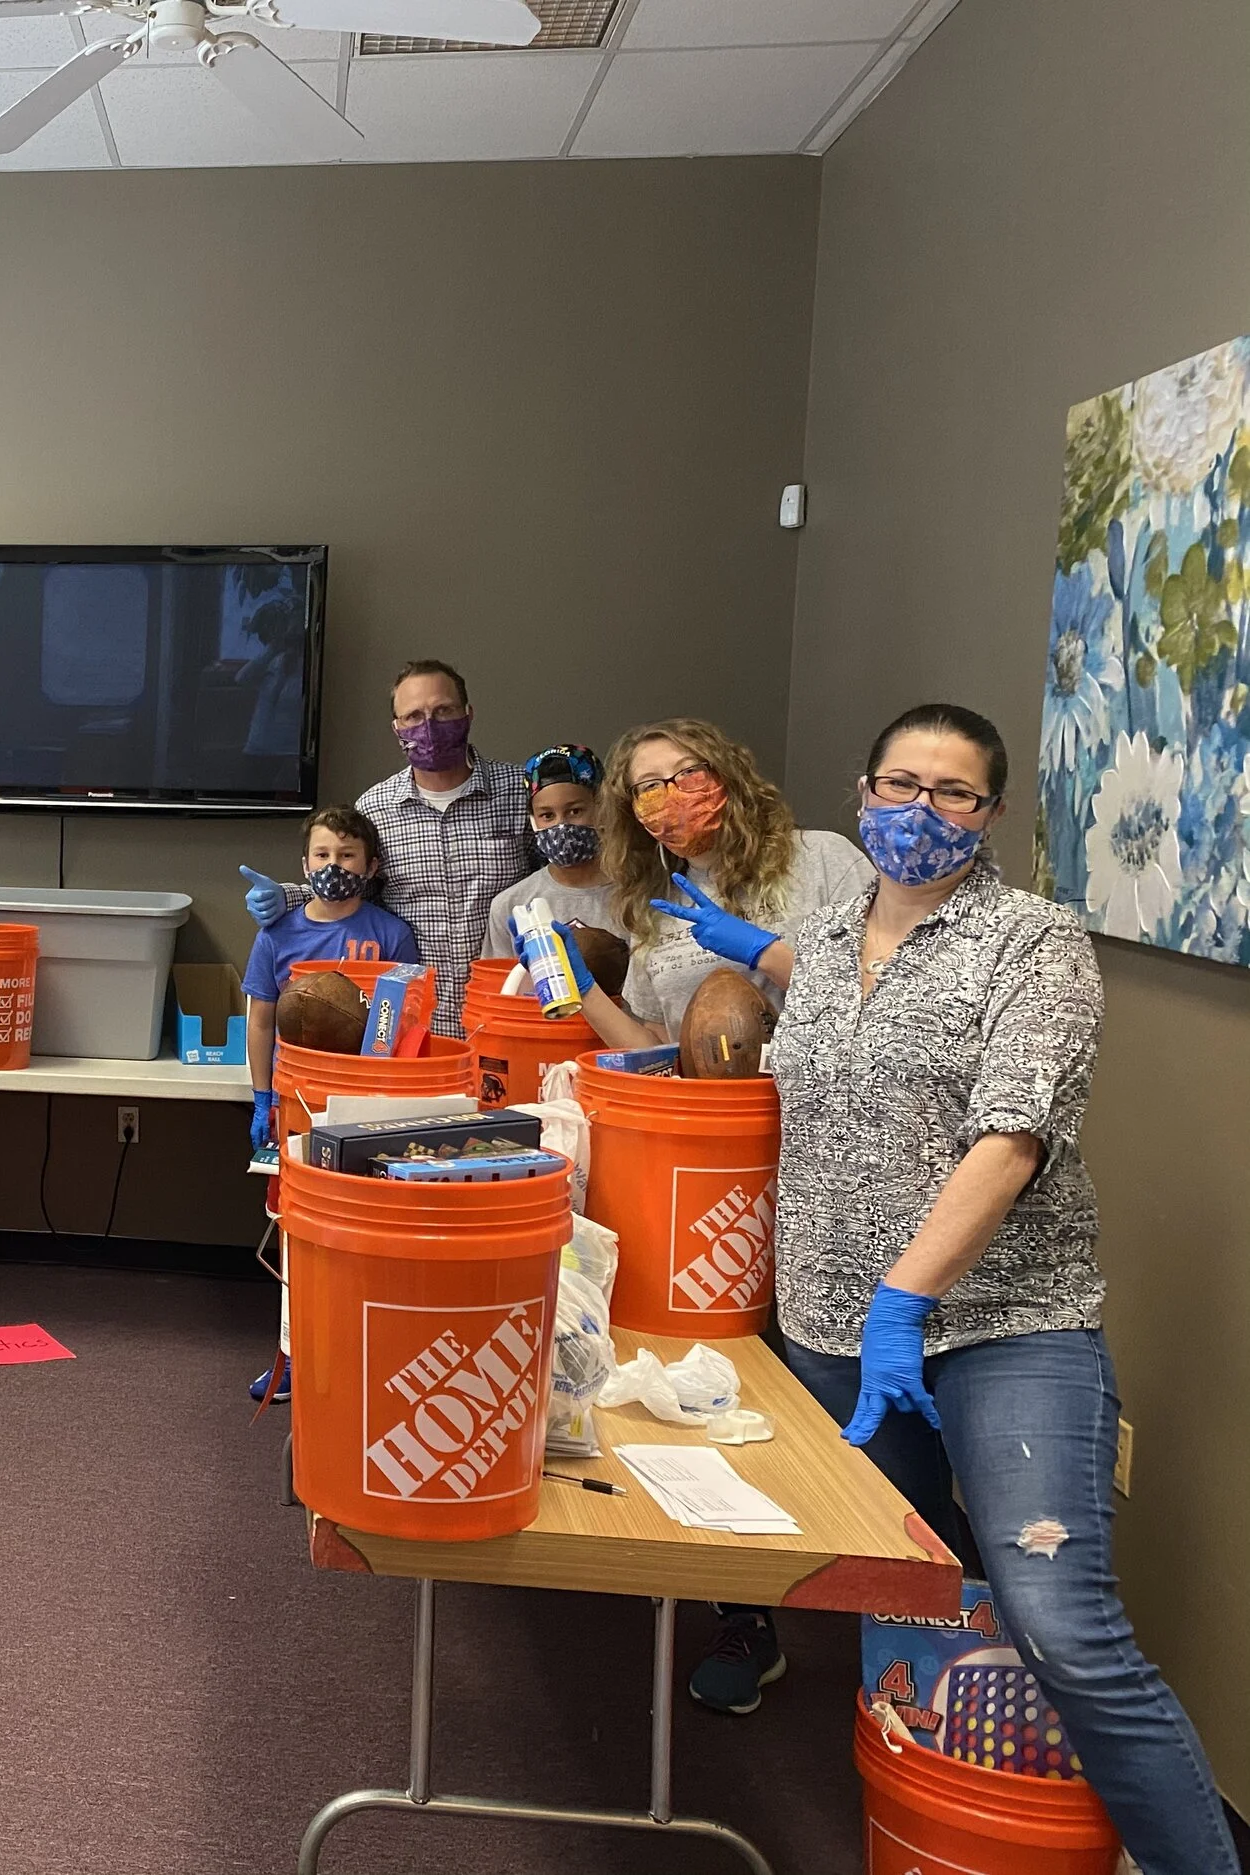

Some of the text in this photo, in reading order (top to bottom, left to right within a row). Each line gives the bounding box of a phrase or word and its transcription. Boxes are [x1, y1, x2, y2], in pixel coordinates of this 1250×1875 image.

[346, 939, 380, 961] 10
[0, 977, 31, 989] MORE
[16, 1010, 31, 1025] DO
[373, 999, 391, 1054] CONNECT 4
[688, 1184, 752, 1242] THE
[672, 1177, 775, 1310] HOM
[384, 1329, 470, 1405] THE
[366, 1305, 542, 1499] HOME
[440, 1372, 536, 1499] DEPOT
[969, 1601, 998, 1638] 4
[881, 1661, 912, 1700] 4
